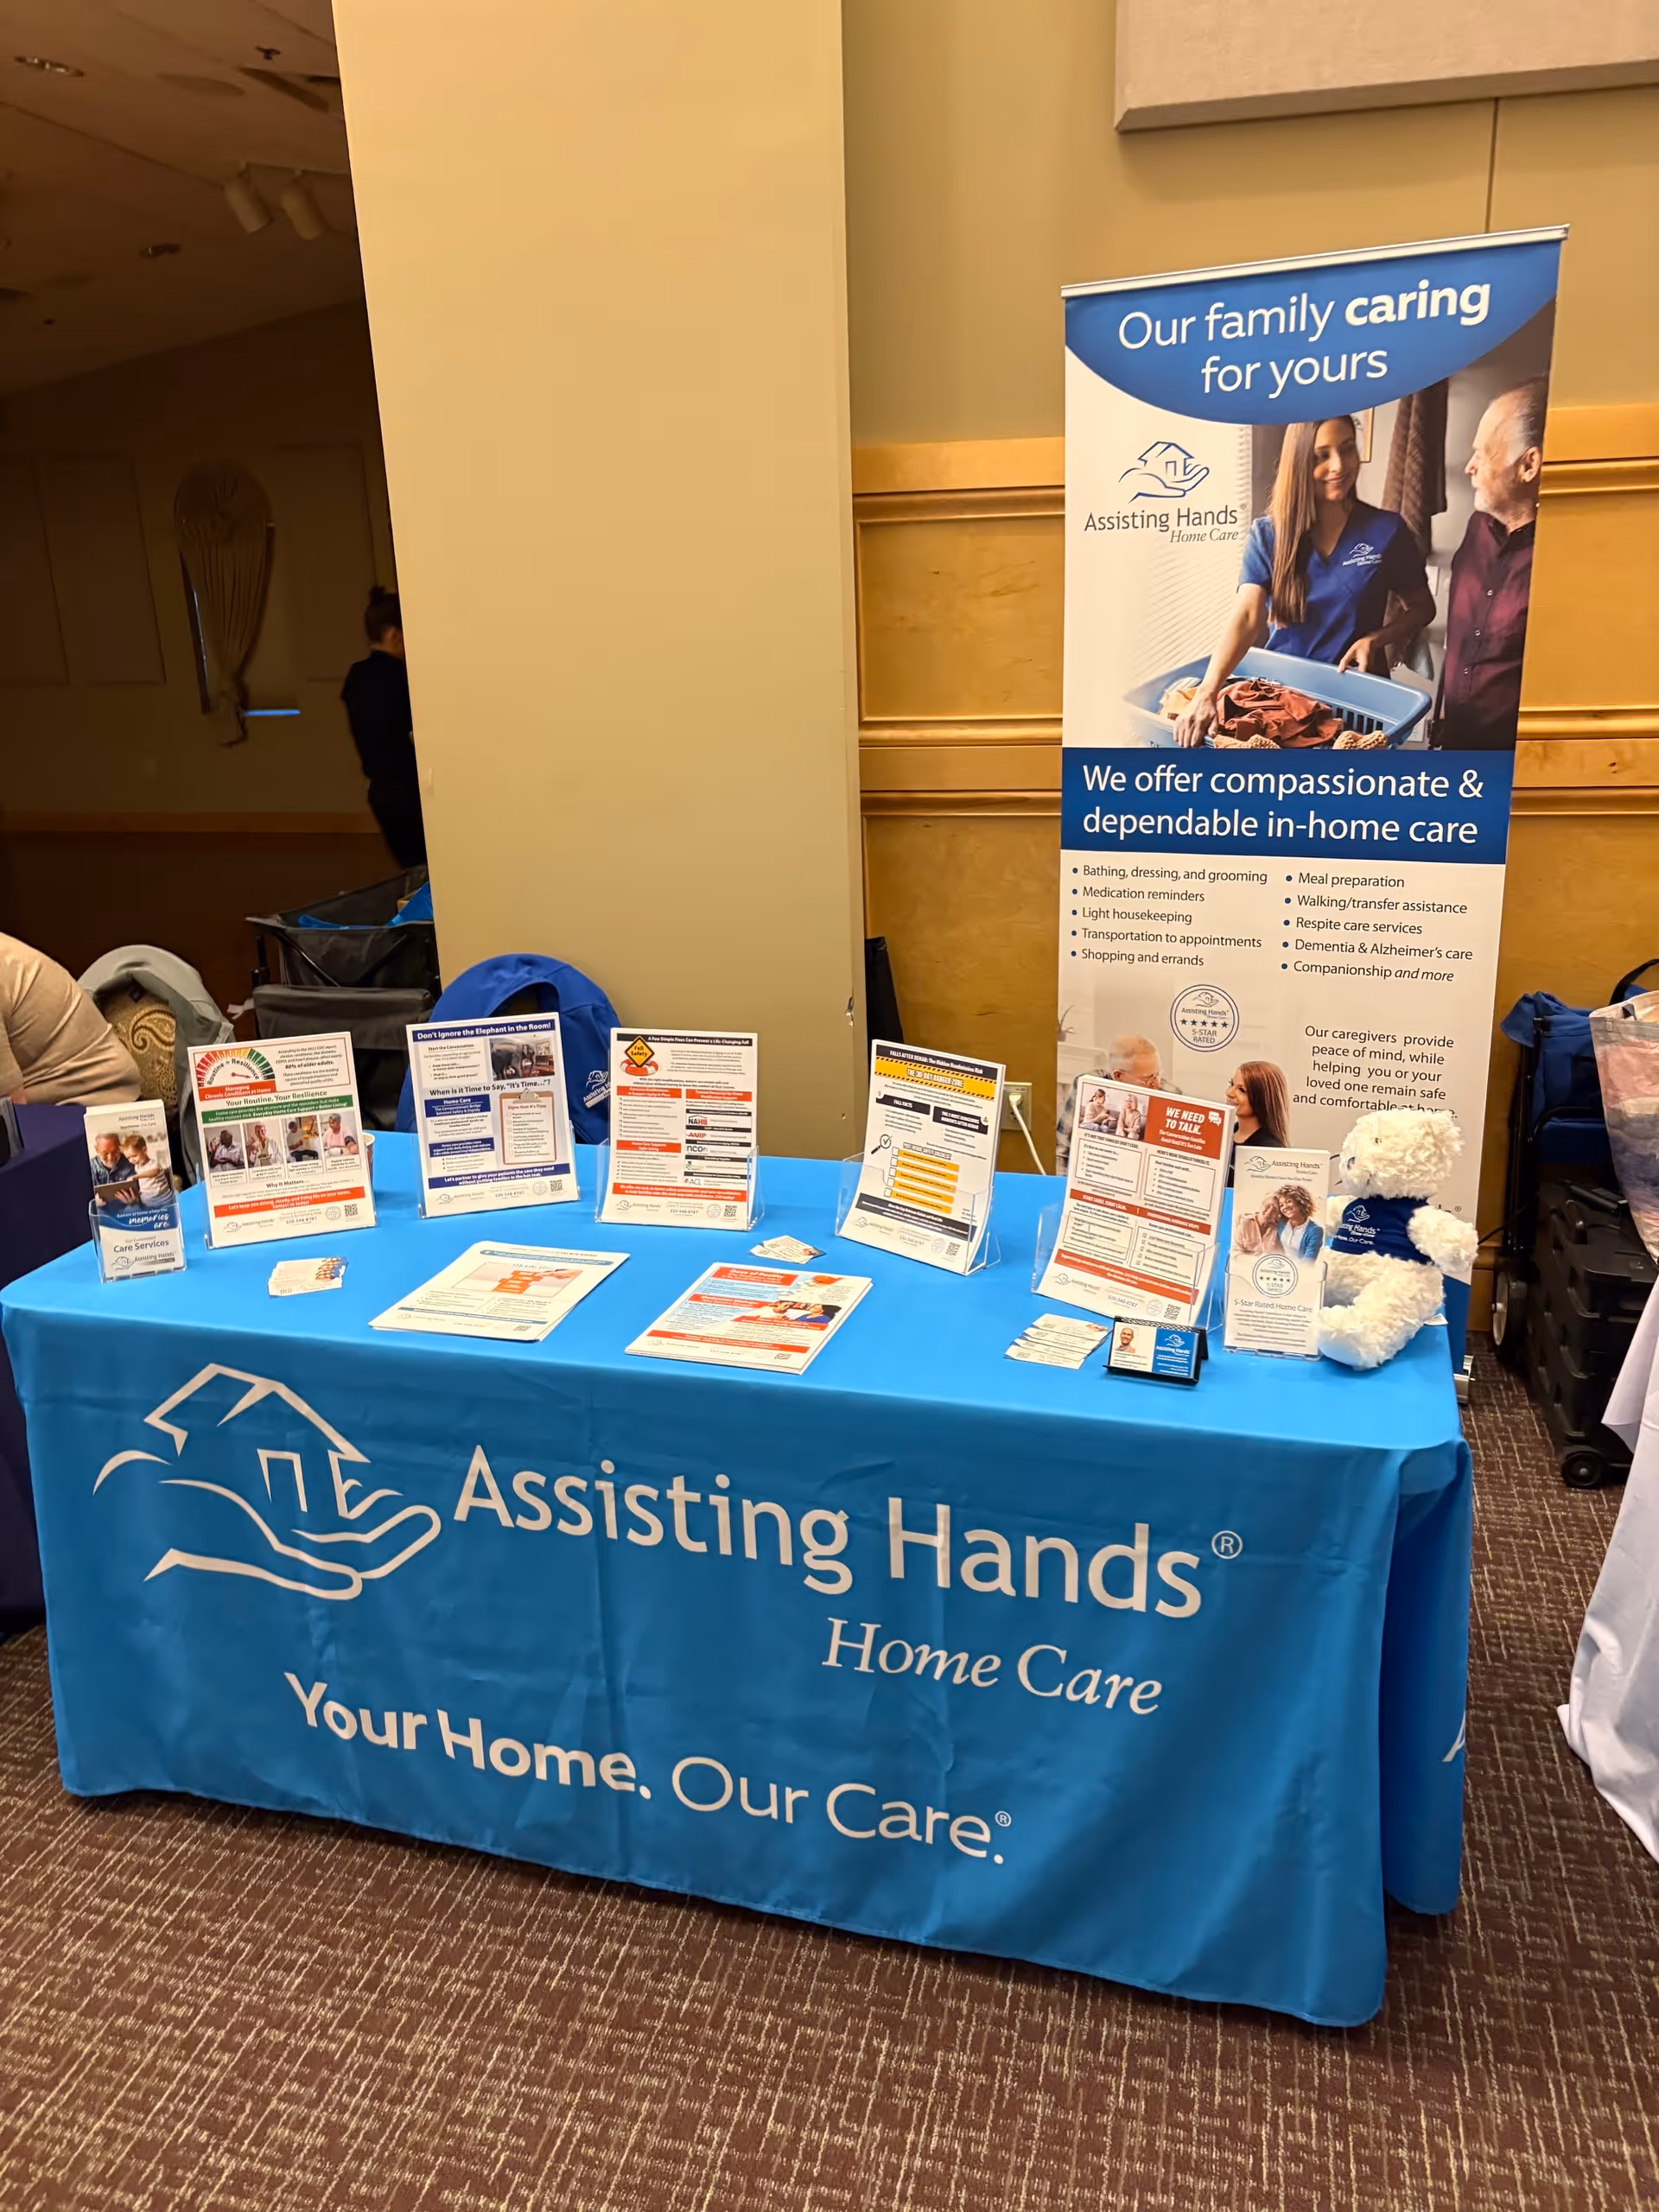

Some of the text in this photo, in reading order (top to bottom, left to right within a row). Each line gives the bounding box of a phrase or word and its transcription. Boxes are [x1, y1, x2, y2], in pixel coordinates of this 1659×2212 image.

[1118, 278, 1491, 350] Our family caring
[1200, 350, 1388, 399] for yours
[1084, 509, 1170, 533] Assisting
[1170, 528, 1239, 543] Home Care
[1083, 764, 1484, 801] We offer compassionate &
[1083, 805, 1478, 844] dependable in-home care
[1083, 864, 1268, 886] Bathing, dressing, and grooming
[1298, 872, 1405, 889] Meal preparation
[1083, 886, 1205, 902] Medication reminders
[1297, 894, 1468, 914] Walking/transfer assistance
[1082, 906, 1192, 926] Light housekeeping
[1296, 916, 1423, 935] Respite care services
[1081, 927, 1262, 948] Transportation to appointments
[1081, 948, 1205, 967] Shopping and errands
[1294, 938, 1473, 960] Dementia & Alzheimer's care
[1294, 960, 1454, 982] Companionship and more
[1181, 1007, 1207, 1016] Assisting
[475, 1026, 506, 1035] Elephant
[1192, 1035, 1216, 1044] RATED
[1305, 1025, 1454, 1048] Our caregivers provide
[1312, 1046, 1445, 1065] peace of mind, while
[207, 1062, 225, 1085] Routine
[232, 1058, 259, 1080] Resilience
[1313, 1059, 1442, 1083] helping you or your
[274, 1094, 290, 1103] Your
[292, 1090, 327, 1099] Resilience
[1306, 1076, 1446, 1100] loved one remain safe
[1294, 1093, 1315, 1104] and
[1166, 1107, 1205, 1123] WE NEED
[1166, 1118, 1201, 1135] TO TALK.
[1271, 1160, 1300, 1169] Assisting
[129, 1213, 169, 1225] memories
[1354, 1224, 1376, 1234] Hands
[114, 1240, 168, 1253] Care Services
[1234, 1299, 1313, 1313] 5-Star Rated Home Care
[453, 1444, 853, 1595] Assisting
[821, 1617, 1162, 1715] Home Care
[283, 1671, 428, 1750] Your
[436, 1708, 652, 1800] Home.
[671, 1756, 810, 1824] Our
